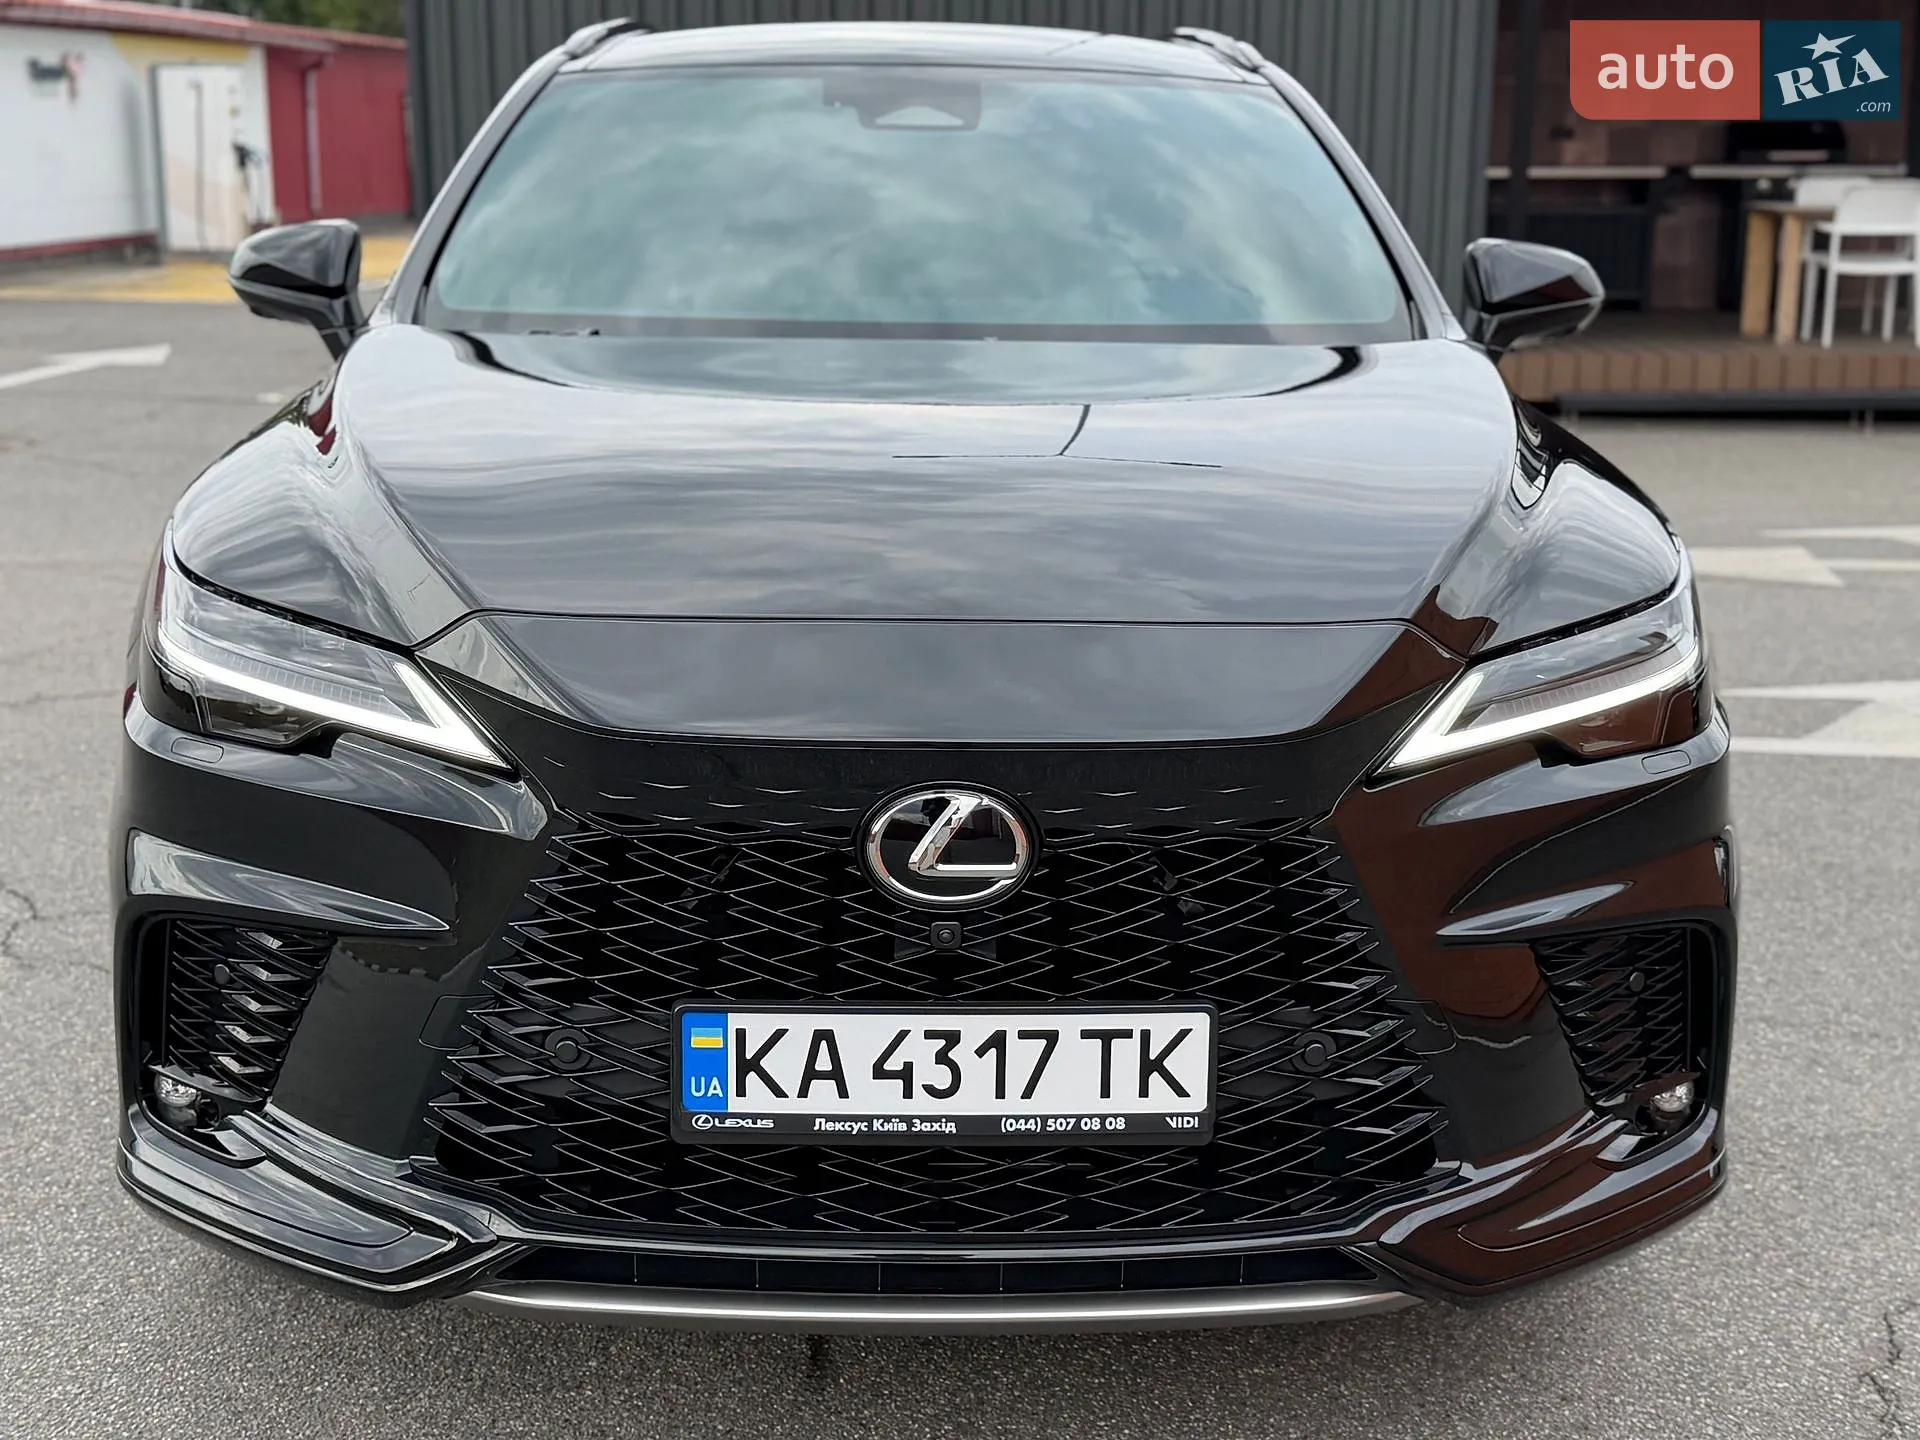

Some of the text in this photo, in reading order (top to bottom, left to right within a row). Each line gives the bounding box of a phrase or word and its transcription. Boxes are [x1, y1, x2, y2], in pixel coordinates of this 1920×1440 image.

[735, 1028, 1194, 1100] KA 4317 TK
[690, 1076, 724, 1097] UA
[714, 1117, 774, 1129] LEXUS
[813, 1117, 957, 1134] Лексус Київ Захід
[1001, 1116, 1126, 1133] (044) 507 08 08
[1165, 1116, 1199, 1129] VIDI
